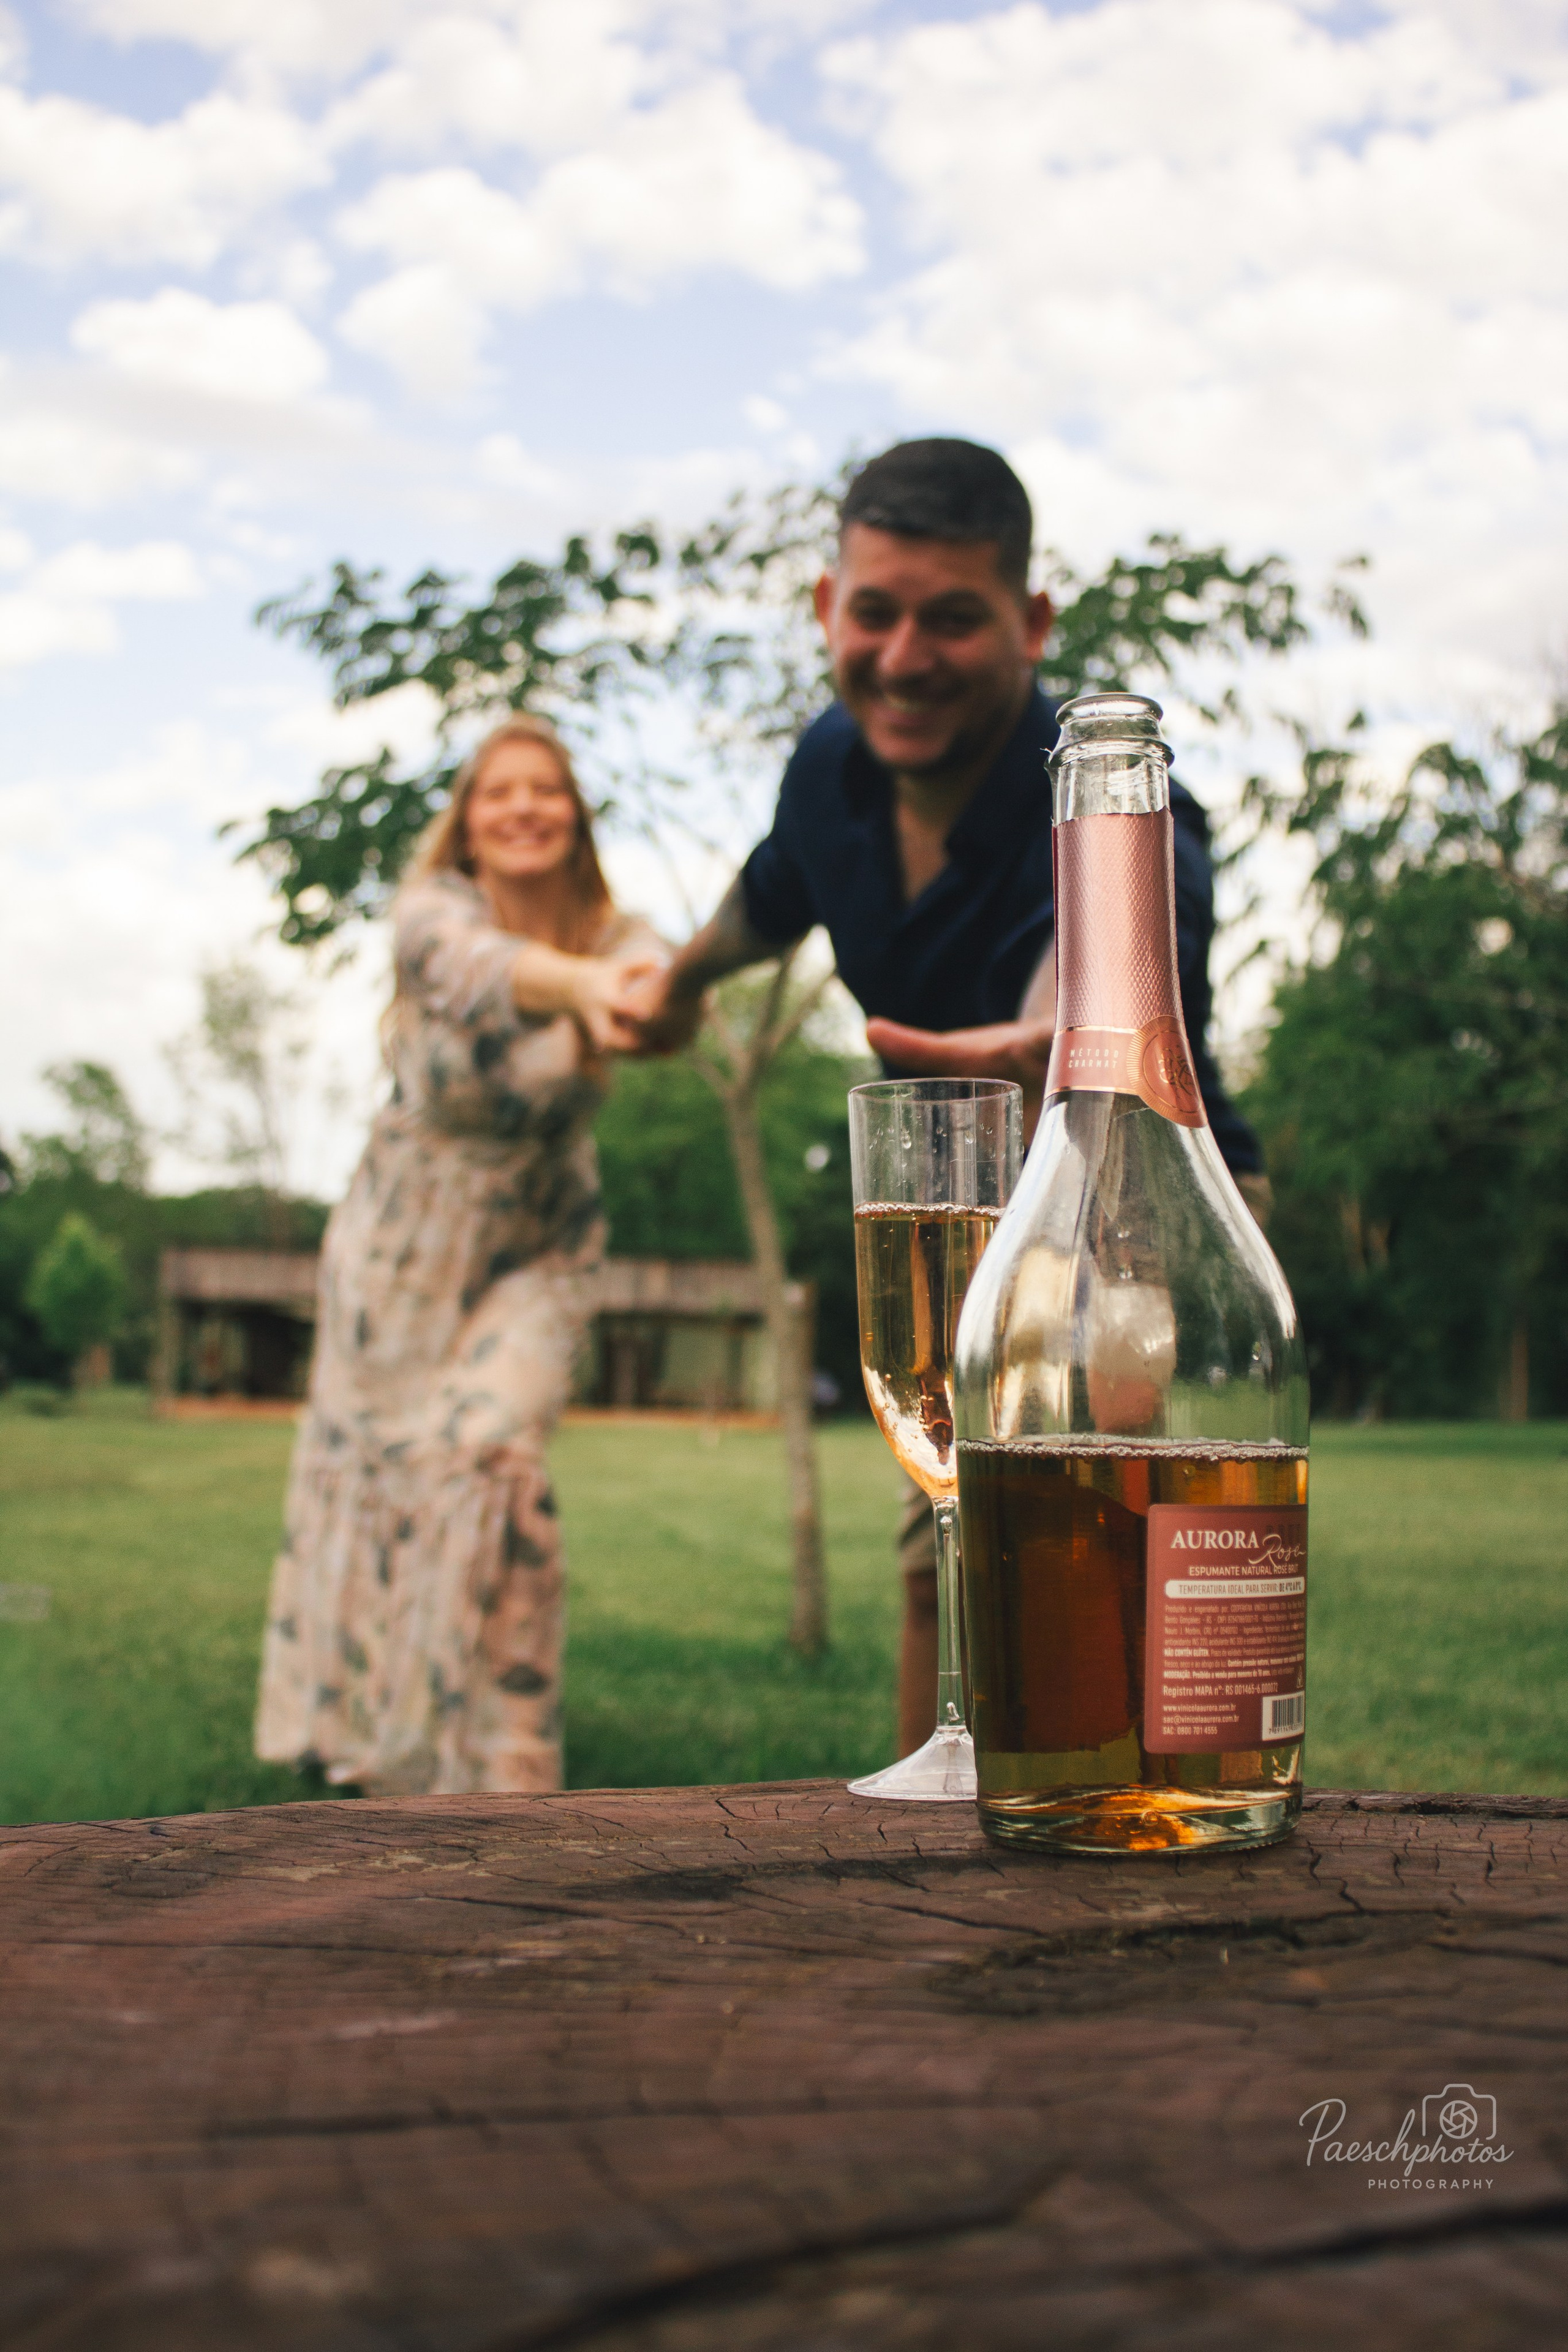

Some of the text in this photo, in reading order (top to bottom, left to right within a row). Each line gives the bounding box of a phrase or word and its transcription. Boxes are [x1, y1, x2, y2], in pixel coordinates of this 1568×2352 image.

[1070, 1047, 1119, 1058] MÉTODO
[1068, 1059, 1117, 1069] CHARMAT
[1171, 1530, 1259, 1549] AURORA
[1189, 1566, 1240, 1576] ESPUMANTE
[1242, 1566, 1272, 1575] NATURAL
[1179, 1585, 1226, 1595] TEMPERATURA
[1228, 1584, 1244, 1594] IDEAL
[1246, 1583, 1259, 1593] PARA
[1164, 1647, 1174, 1657] NÃO
[1175, 1648, 1193, 1657] CONTÉM
[1163, 1686, 1193, 1698] Registro
[1195, 1685, 1213, 1697] MAPA
[1226, 1684, 1234, 1695] RS
[1163, 1703, 1236, 1713] www.vinicolaaurora.com.br
[1163, 1714, 1239, 1725] sac@vinicolaaurora.com.br
[1177, 1726, 1191, 1735] 0800
[1193, 1726, 1202, 1735] 701
[1204, 1726, 1218, 1735] 4555
